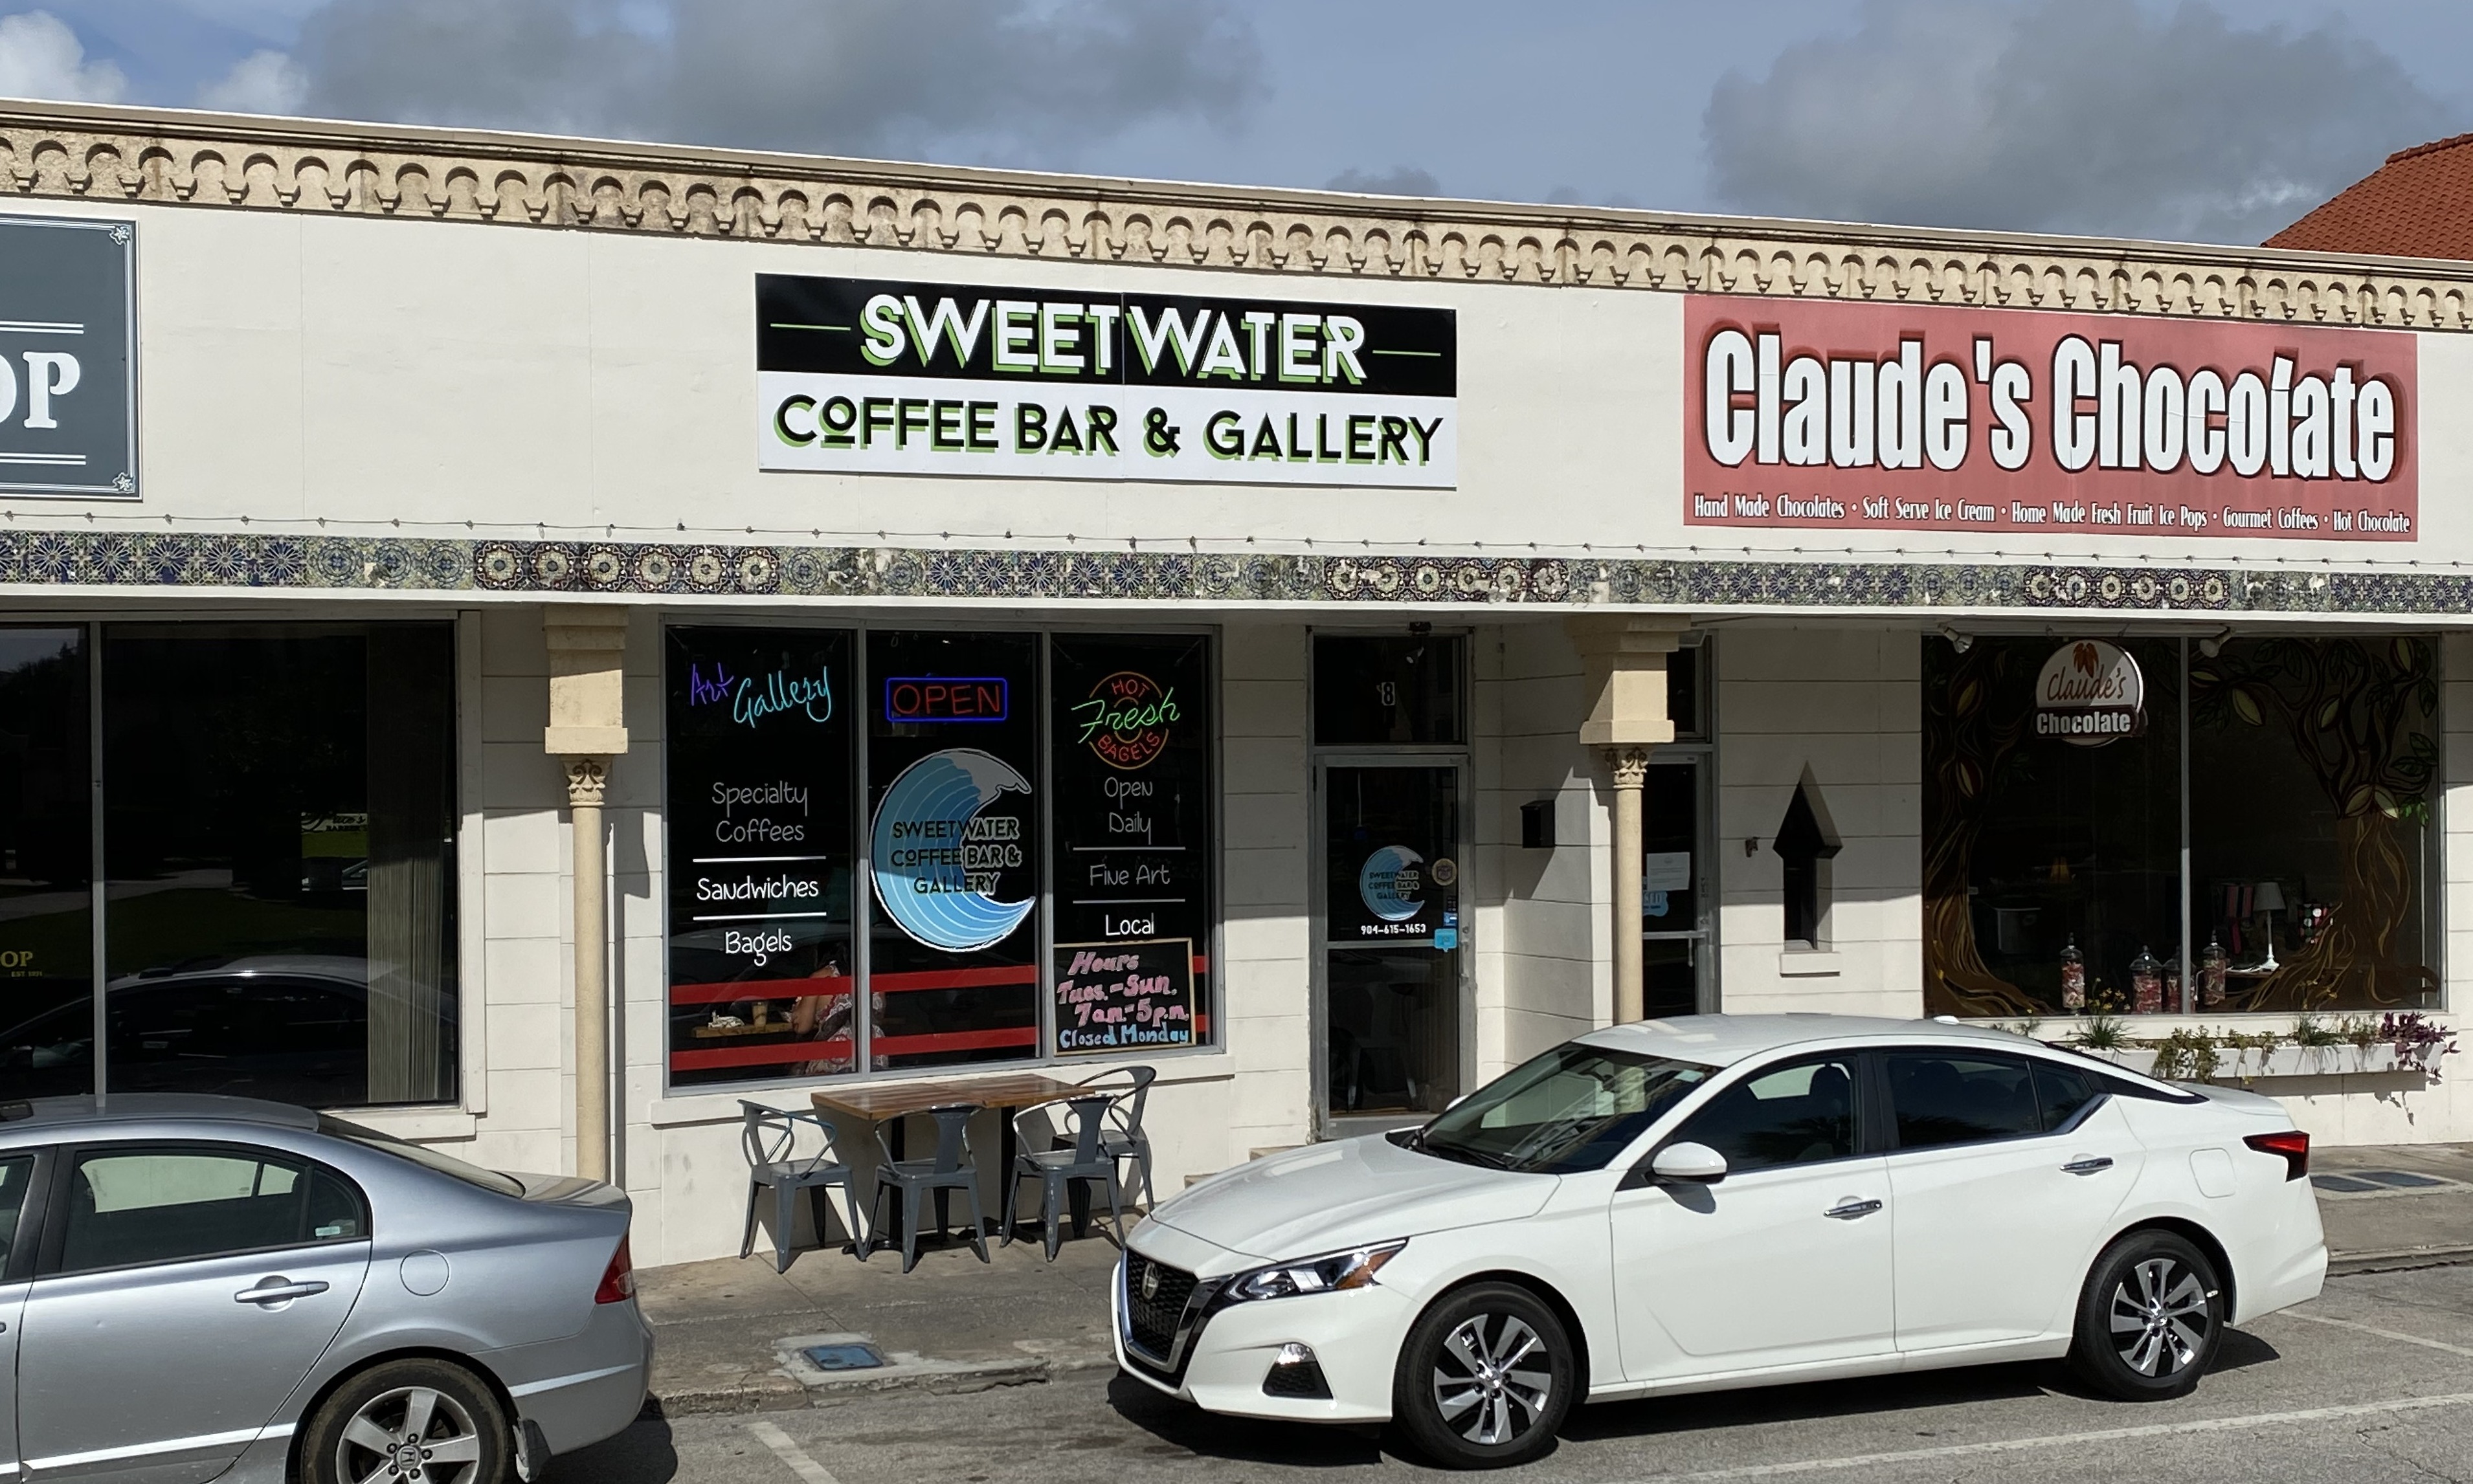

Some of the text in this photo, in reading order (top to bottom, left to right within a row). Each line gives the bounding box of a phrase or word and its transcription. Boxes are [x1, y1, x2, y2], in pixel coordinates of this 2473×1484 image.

[860, 294, 1367, 385] SWEETWATER
[0, 351, 80, 428] P
[1704, 327, 2395, 482] Claude's Chocolate
[773, 393, 1444, 467] COFFEE BAR & GALLERY
[1694, 494, 2410, 533] Hand Made Chocolates Soft Serve Ice Cream Home Made Fresh Fruit Ice Pops Gourmet Coffees Hot Chocolate
[691, 662, 832, 728] Art Gallery
[1112, 679, 1150, 697] HOT
[2047, 663, 2126, 701] Claude's
[893, 684, 1000, 715] OPEN
[1071, 687, 1180, 744] Fresh
[2037, 711, 2131, 734] Chocolate
[1098, 731, 1160, 762] BAGELS
[711, 781, 808, 818] Specialty
[1104, 777, 1153, 809] Open
[716, 818, 805, 842] Coffees
[893, 819, 1018, 839] SWEETWATER
[1109, 811, 1151, 845] Daily
[891, 845, 1021, 867] COFFEE BAR &
[697, 874, 819, 900] Sandwiches
[913, 872, 1000, 894] GALLERY
[1090, 864, 1170, 886] Fine Art
[1369, 870, 1419, 880] SWEETWATER
[1369, 881, 1396, 890] COFFEE
[1376, 891, 1411, 900] GALLERY
[1105, 913, 1154, 936] Local
[1361, 924, 1426, 935] 904-615-1653
[725, 928, 792, 966] Bagels
[1068, 951, 1139, 975] Hours
[1059, 1021, 1189, 1048] Closed Monday
